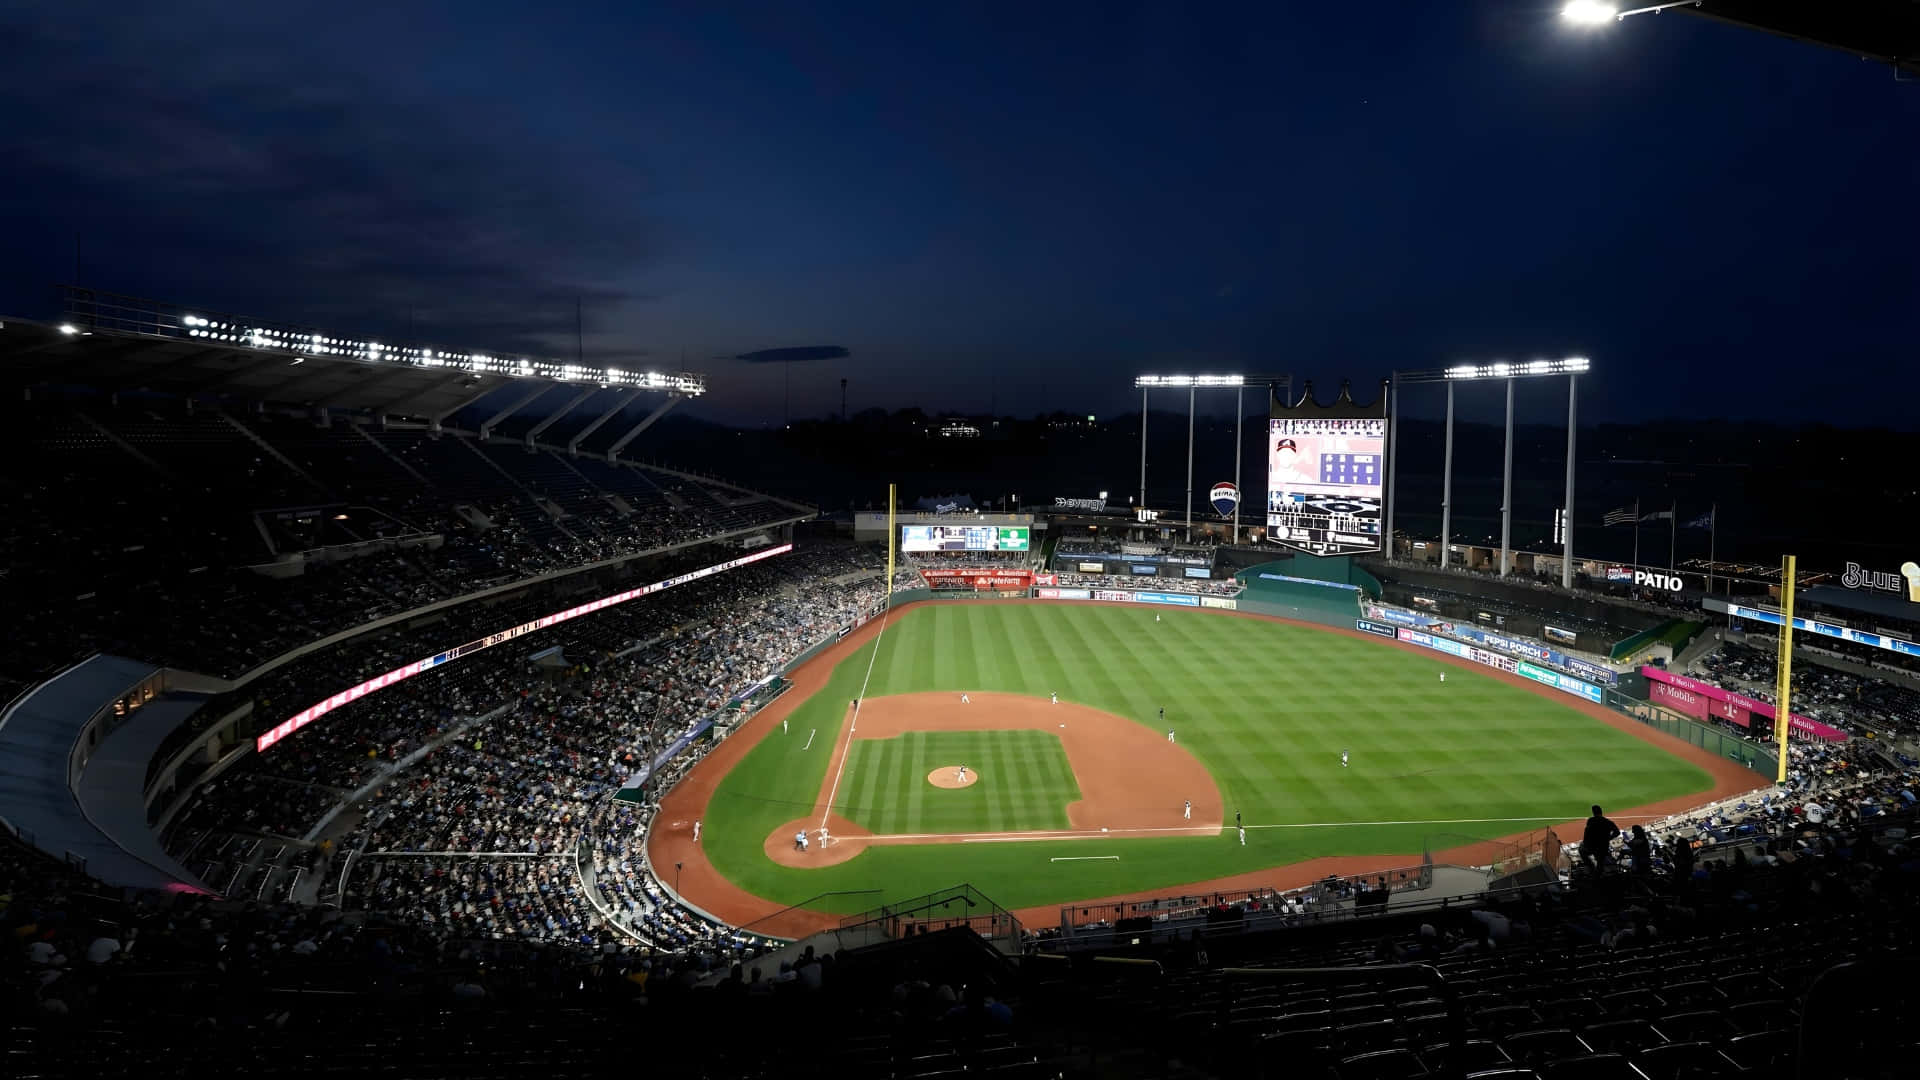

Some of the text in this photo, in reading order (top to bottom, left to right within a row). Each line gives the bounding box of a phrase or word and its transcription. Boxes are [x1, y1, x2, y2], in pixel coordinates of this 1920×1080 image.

[1066, 498, 1106, 512] evergy
[1635, 571, 1683, 592] PATIO
[1841, 561, 1900, 592] BLUE
[1483, 634, 1508, 649] PEPSI
[1509, 640, 1541, 658] PORCH
[1570, 660, 1610, 679] royals.com
[1667, 685, 1695, 704] Mobile
[1793, 716, 1815, 730] Mobile
